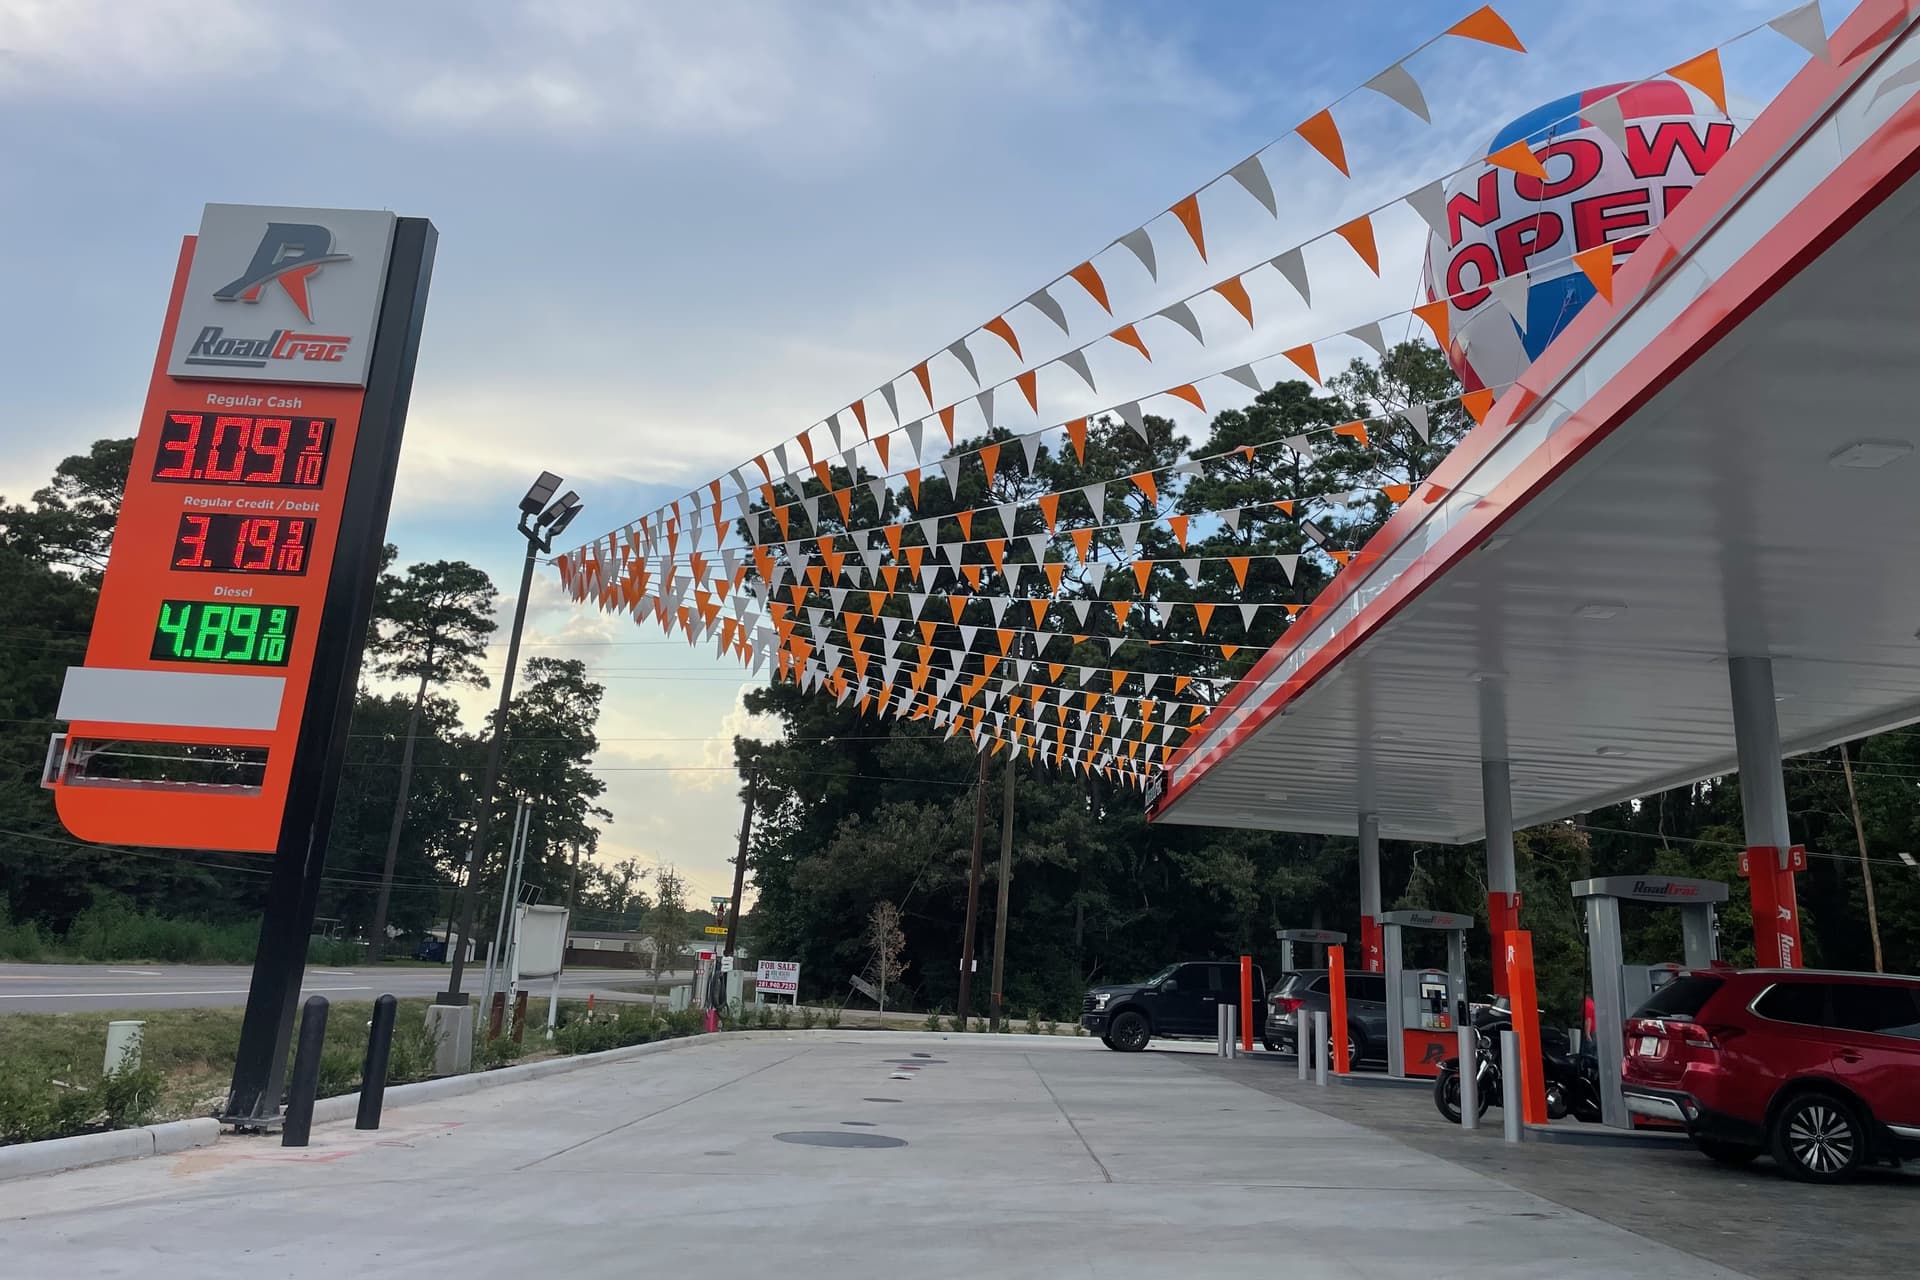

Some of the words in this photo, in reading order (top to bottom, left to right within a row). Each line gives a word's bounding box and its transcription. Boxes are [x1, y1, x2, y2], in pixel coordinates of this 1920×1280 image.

[1447, 122, 1735, 250] NOW
[1447, 185, 1694, 312] OPE
[206, 393, 263, 407] Regular
[267, 396, 302, 409] Cash
[156, 415, 293, 483] 3.09
[183, 496, 232, 508] Regular
[236, 498, 275, 510] Credit
[176, 515, 280, 570] 3.19
[213, 586, 253, 597] Diesel
[159, 603, 262, 660] 4.89
[1793, 852, 1802, 866] 5
[760, 961, 775, 970] FOR
[777, 962, 797, 971] SALE
